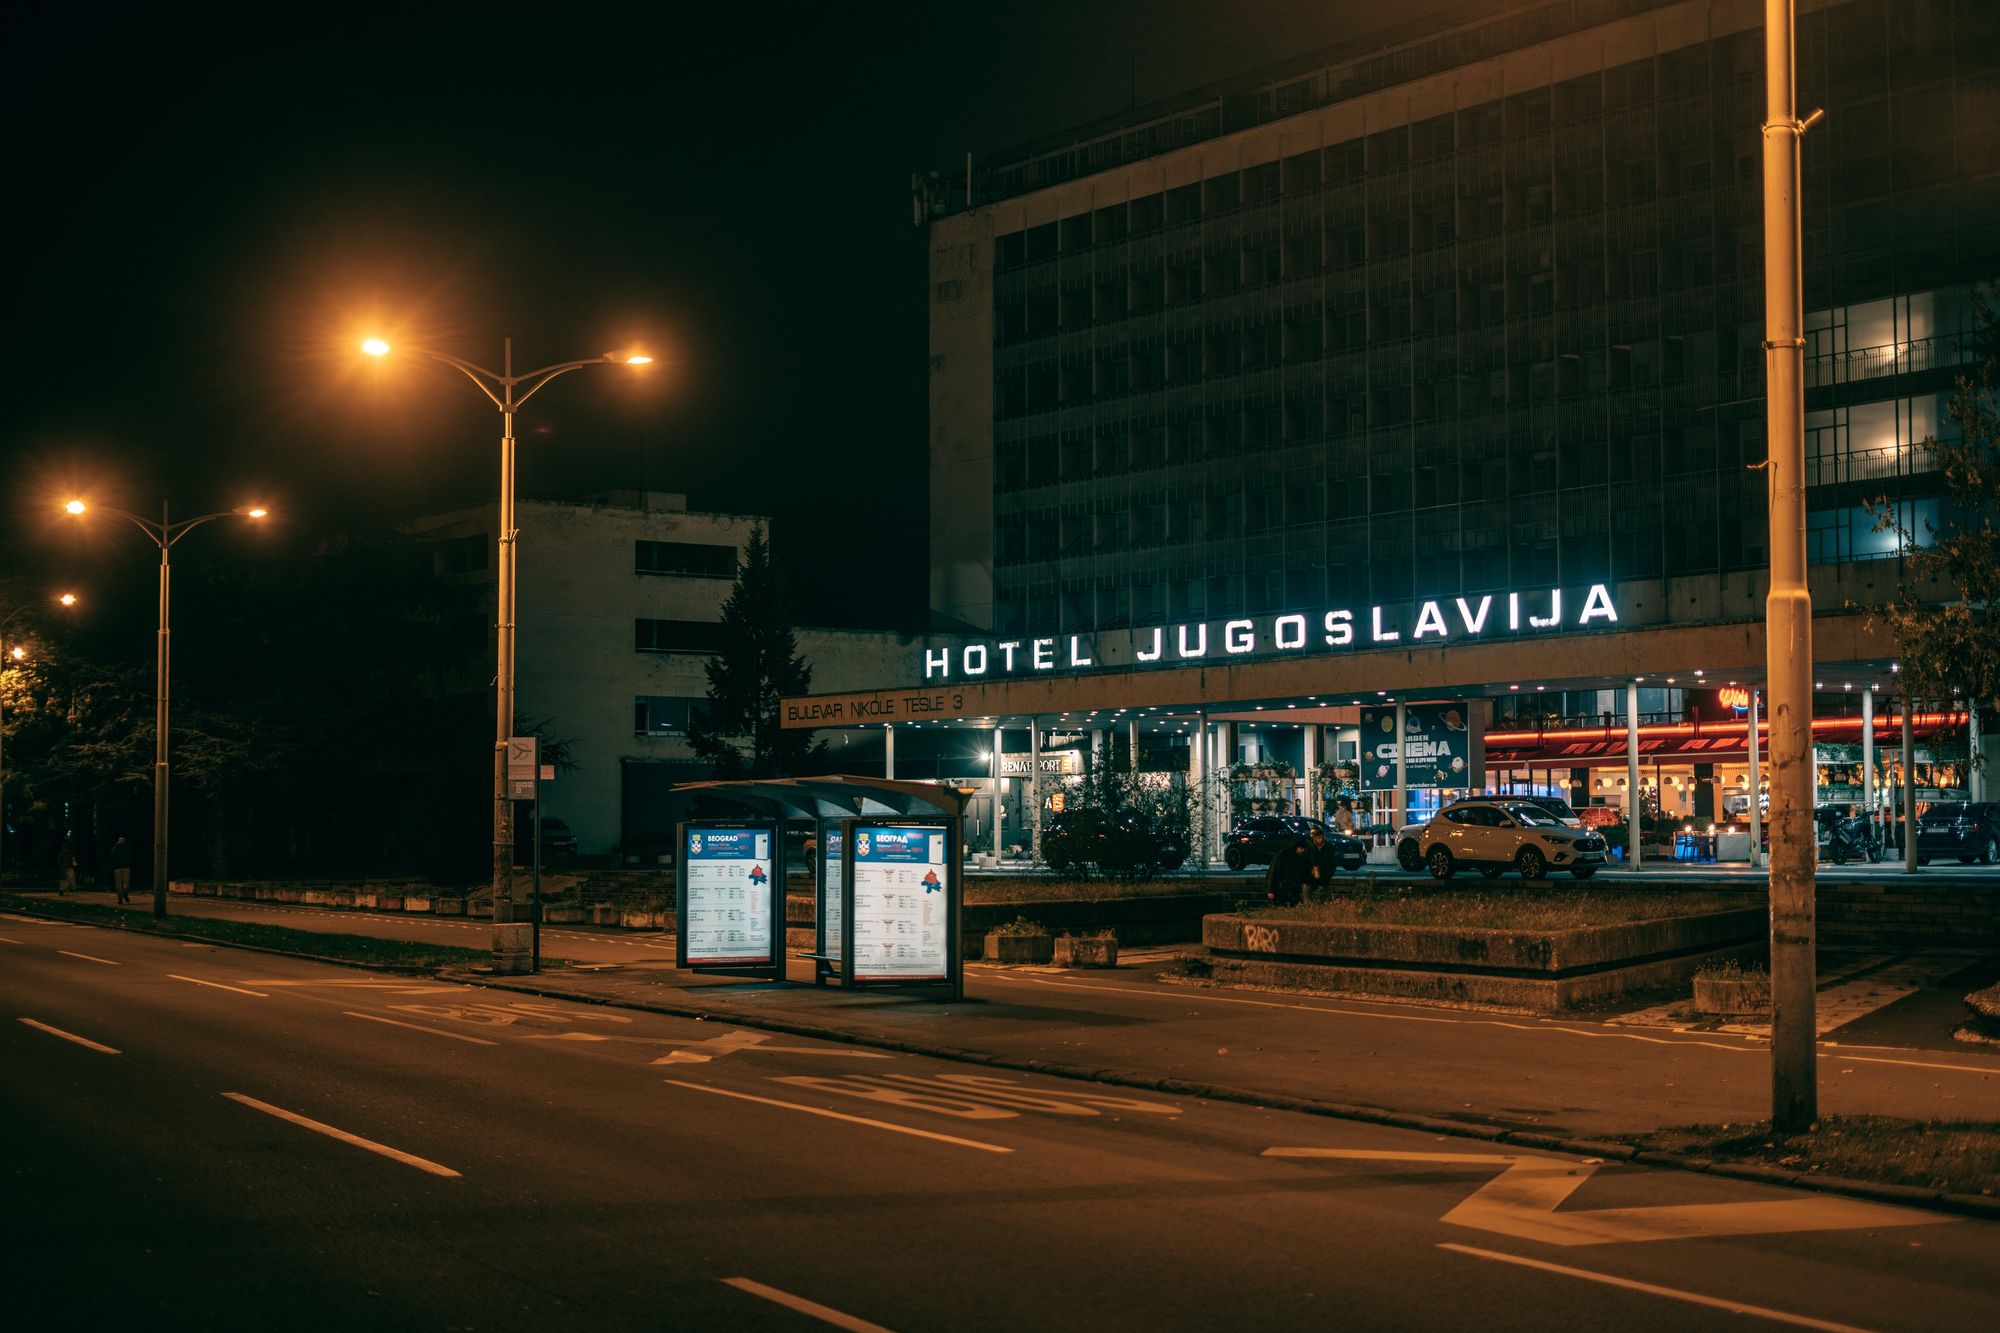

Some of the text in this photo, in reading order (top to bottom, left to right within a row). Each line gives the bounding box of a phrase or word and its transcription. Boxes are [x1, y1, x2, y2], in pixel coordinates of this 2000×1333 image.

[925, 583, 1618, 679] HOTEL JUGOSLAVIJA
[788, 694, 964, 721] BULEVAR NIKOLE TESLE 3
[1405, 734, 1429, 742] ARDEN
[707, 834, 739, 843] BEOGRAD
[875, 833, 909, 844] БЕОГРАД
[761, 1072, 1184, 1120] BUS
